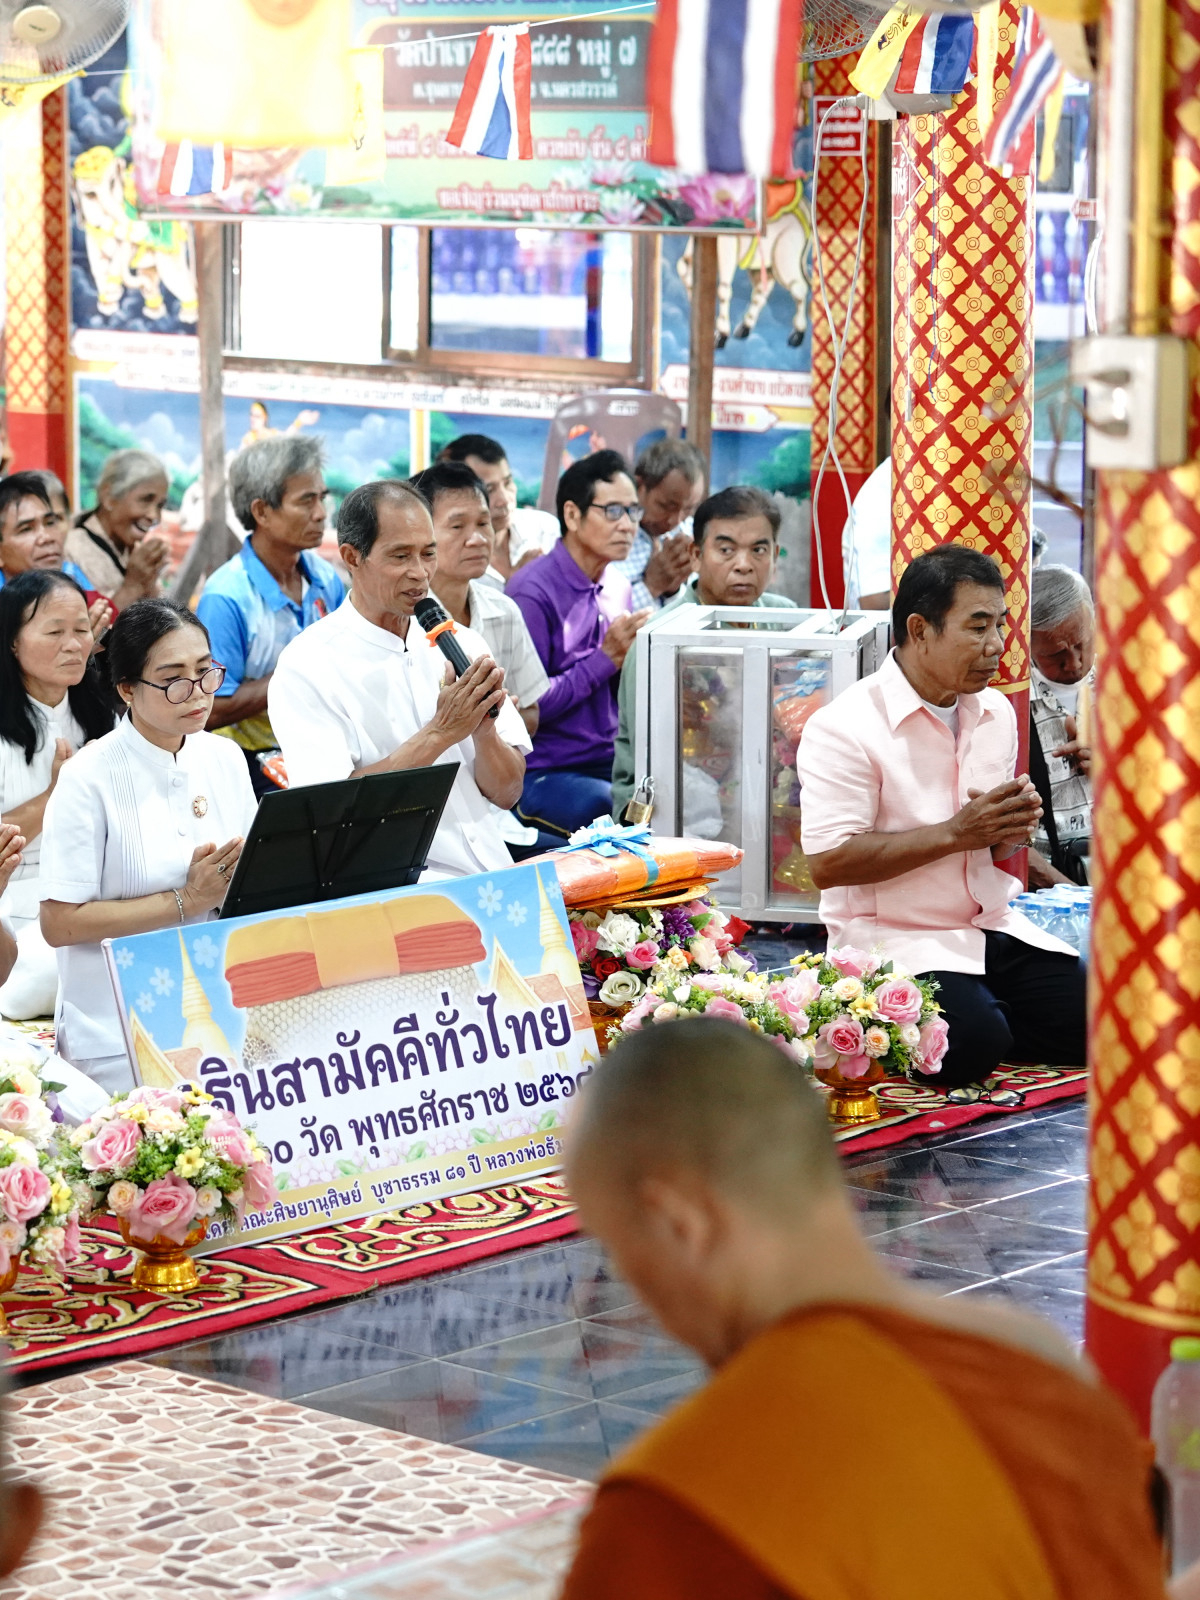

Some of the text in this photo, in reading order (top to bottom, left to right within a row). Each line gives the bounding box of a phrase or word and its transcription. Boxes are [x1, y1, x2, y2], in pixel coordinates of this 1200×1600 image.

[178, 993, 573, 1115] ฐินสามัคคีทั่วไทย
[300, 1115, 343, 1157] วัด
[349, 1083, 510, 1160] พุทธศักราช
[370, 1168, 441, 1205] บูชาธรรม
[445, 1166, 466, 1180] ๘๑
[467, 1153, 482, 1174] ปี
